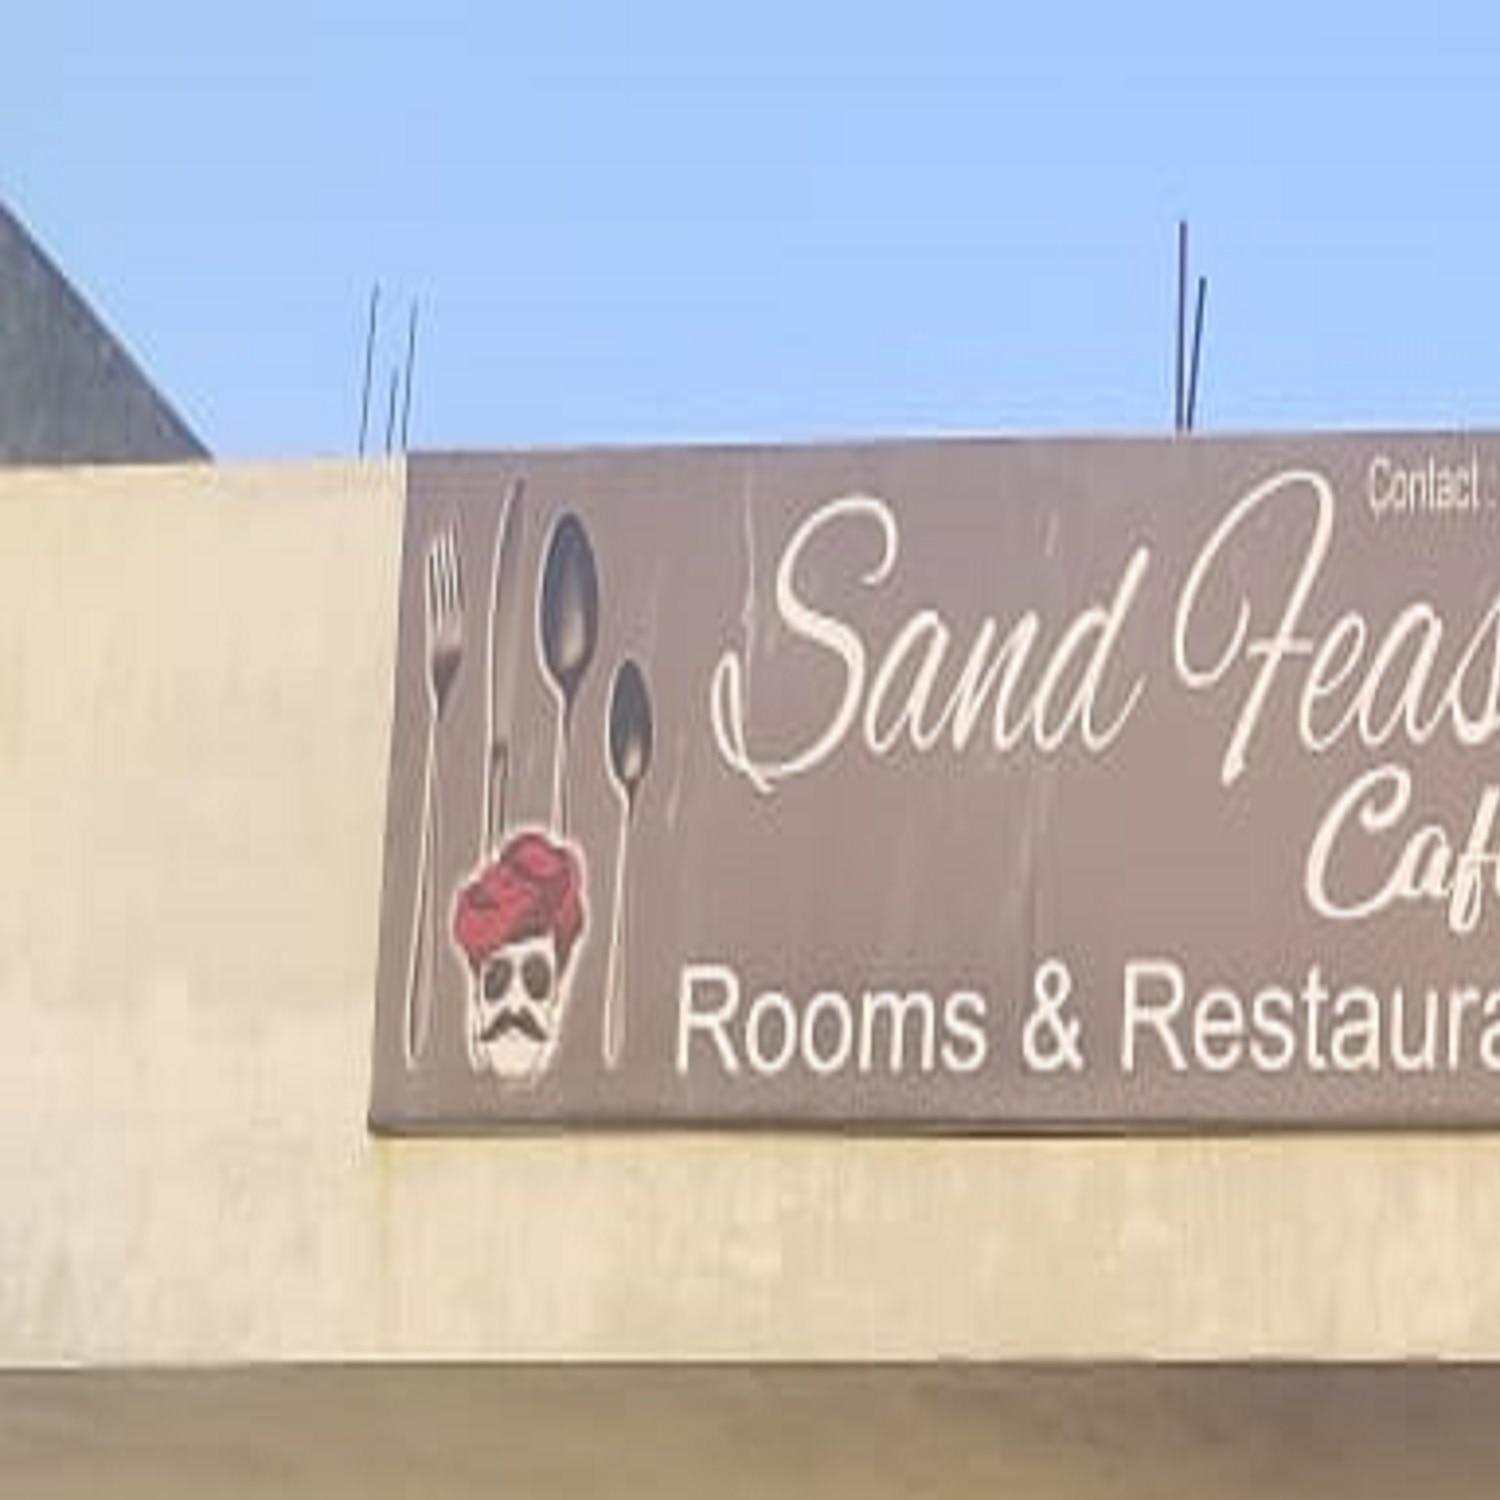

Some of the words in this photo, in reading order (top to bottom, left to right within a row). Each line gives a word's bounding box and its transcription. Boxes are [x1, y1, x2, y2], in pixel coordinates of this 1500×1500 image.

[710, 494, 1150, 795] Sand
[675, 962, 989, 1074] Rooms
[1021, 957, 1084, 1073] &
